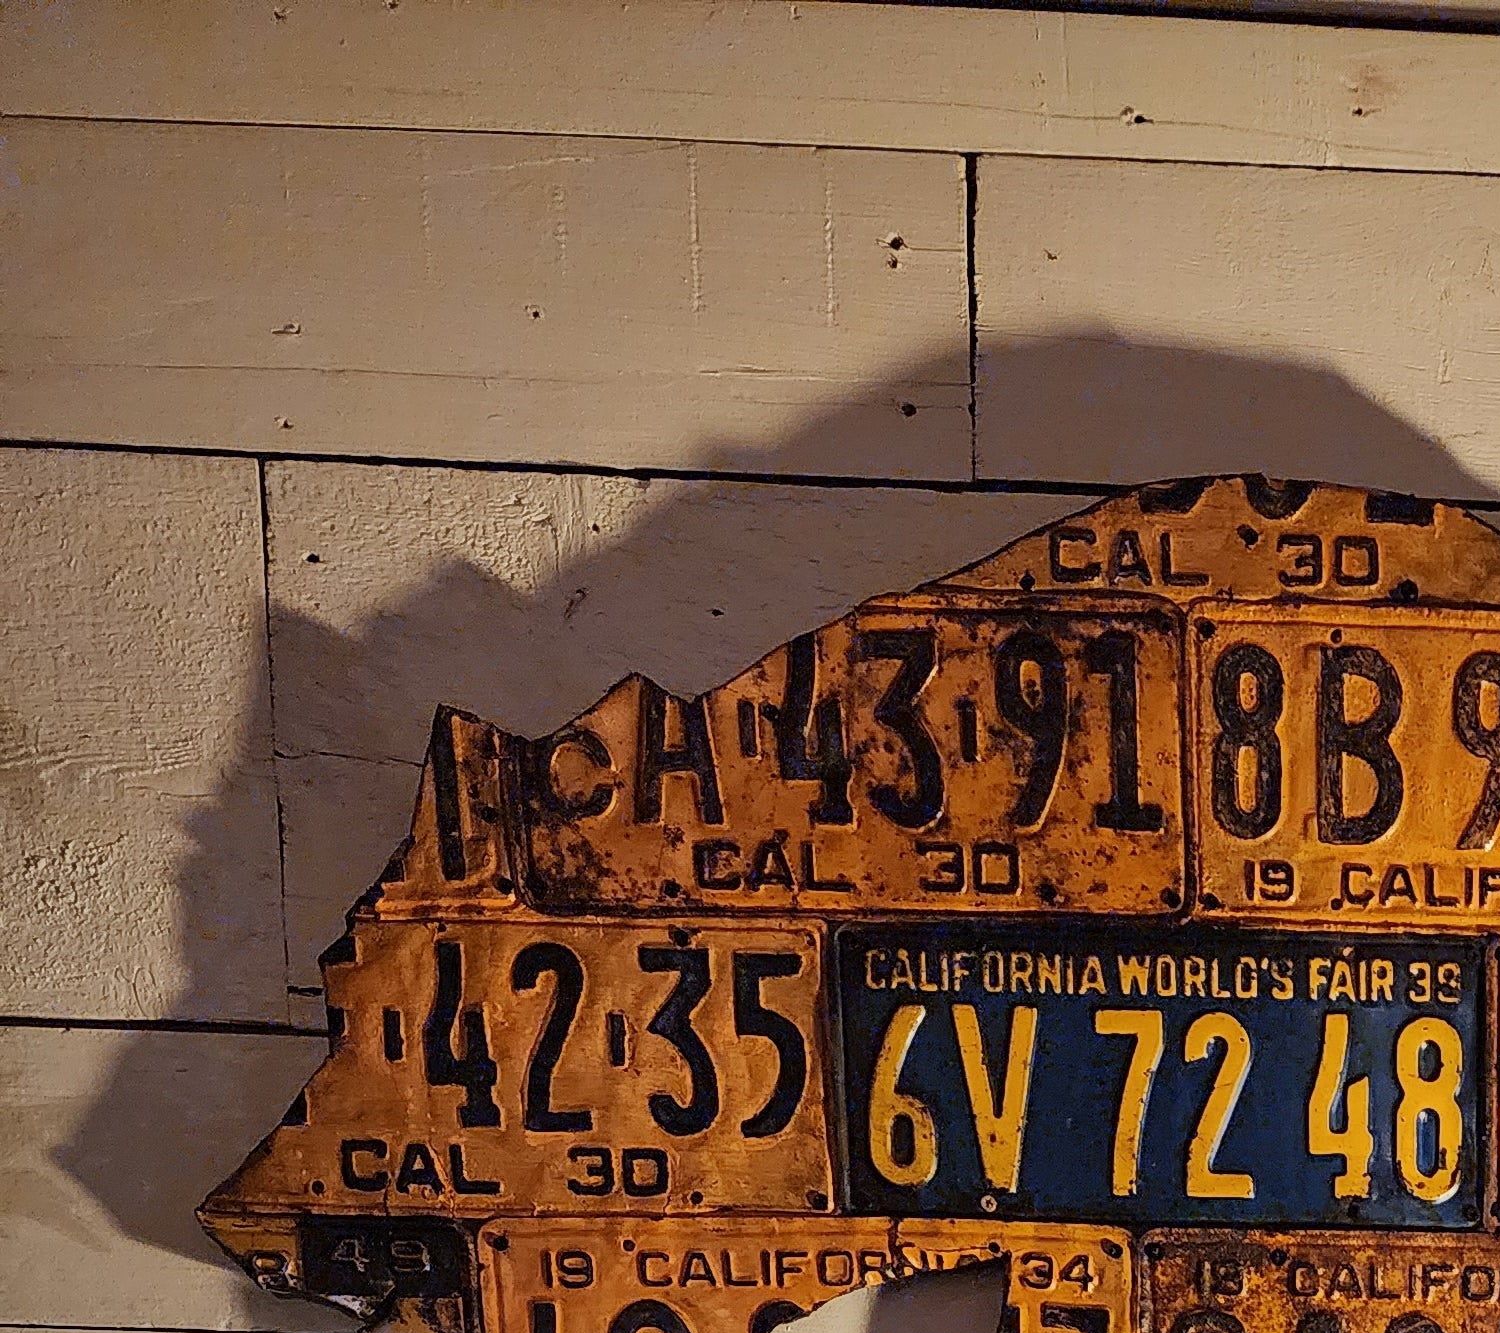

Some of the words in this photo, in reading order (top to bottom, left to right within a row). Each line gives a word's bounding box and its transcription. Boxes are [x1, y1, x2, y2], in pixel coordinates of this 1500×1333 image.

[1048, 527, 1210, 587] CAL
[1277, 534, 1381, 588] 30
[692, 840, 857, 895] CAL
[916, 841, 1020, 896] 30
[1243, 860, 1296, 902] 19
[863, 948, 1105, 997] CALIFORNIA
[1117, 954, 1296, 1000] WORLD'S
[1308, 949, 1394, 1002] FAIR
[340, 1140, 502, 1194] CAL
[568, 1148, 668, 1197] 30
[542, 1249, 595, 1290] 19
[1020, 1252, 1098, 1293] 34
